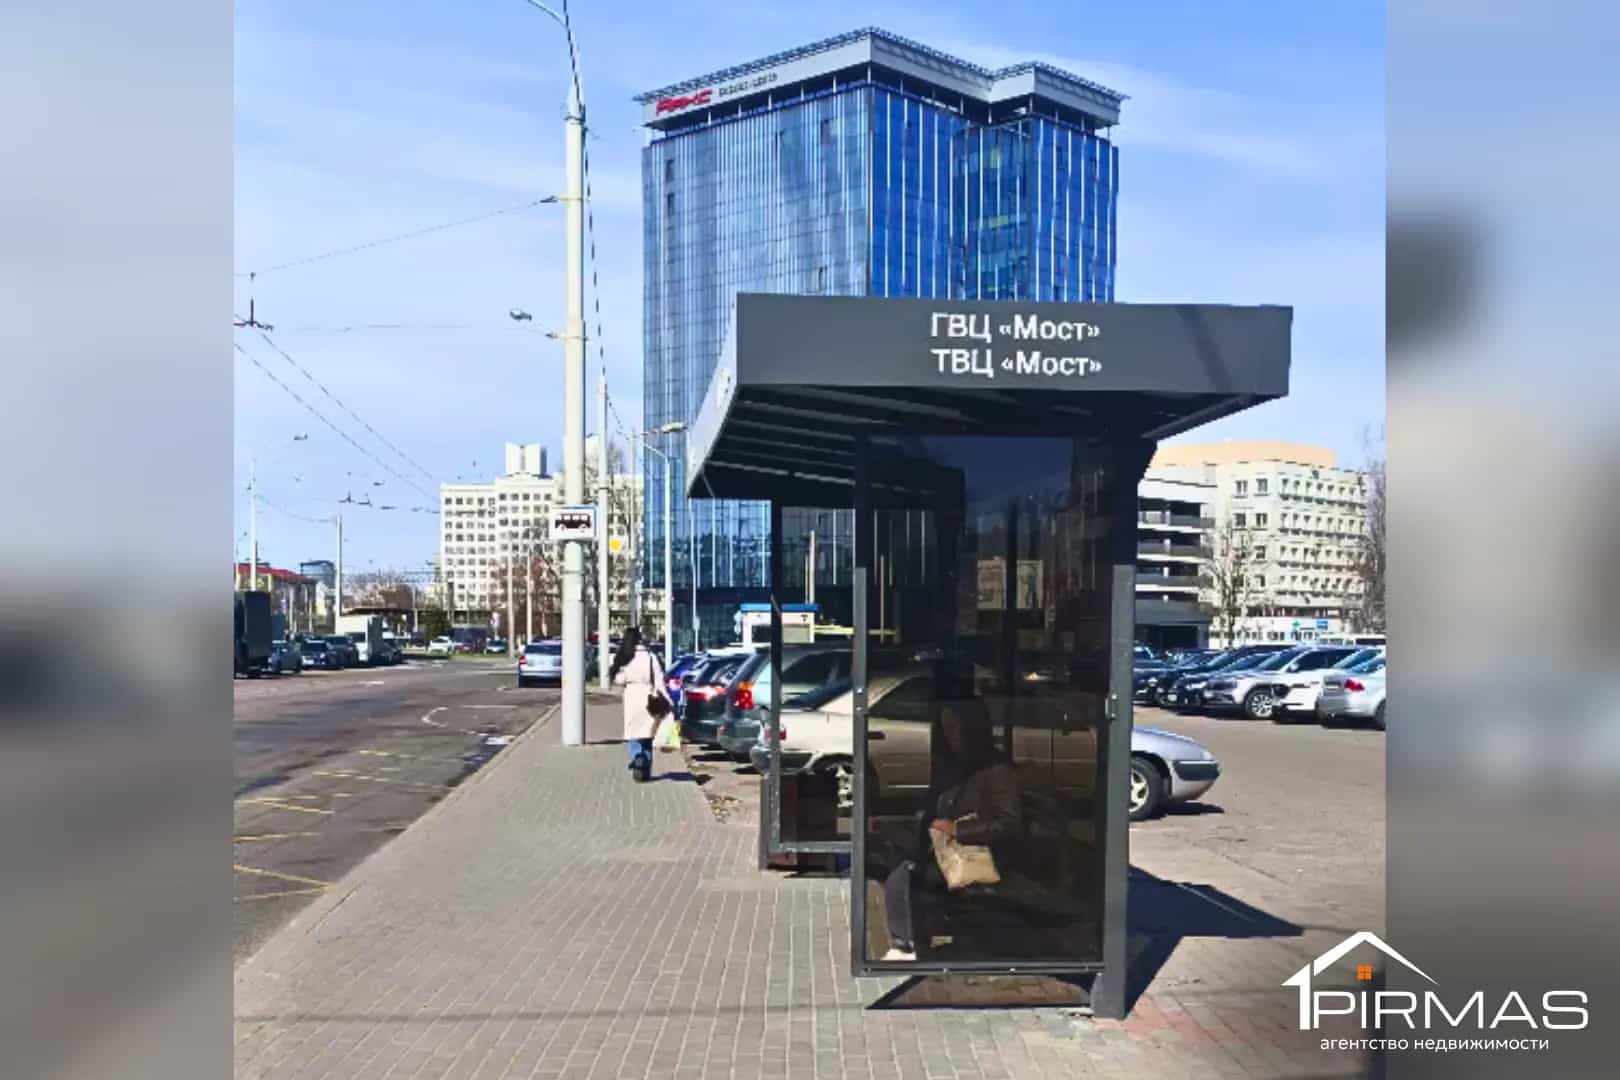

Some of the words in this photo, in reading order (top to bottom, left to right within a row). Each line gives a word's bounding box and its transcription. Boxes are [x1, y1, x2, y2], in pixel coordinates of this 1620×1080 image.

[931, 312, 992, 343] ГВЦ
[999, 314, 1100, 341] «Мост»
[931, 349, 994, 378] ТВЦ
[1001, 351, 1102, 376] «Мост»
